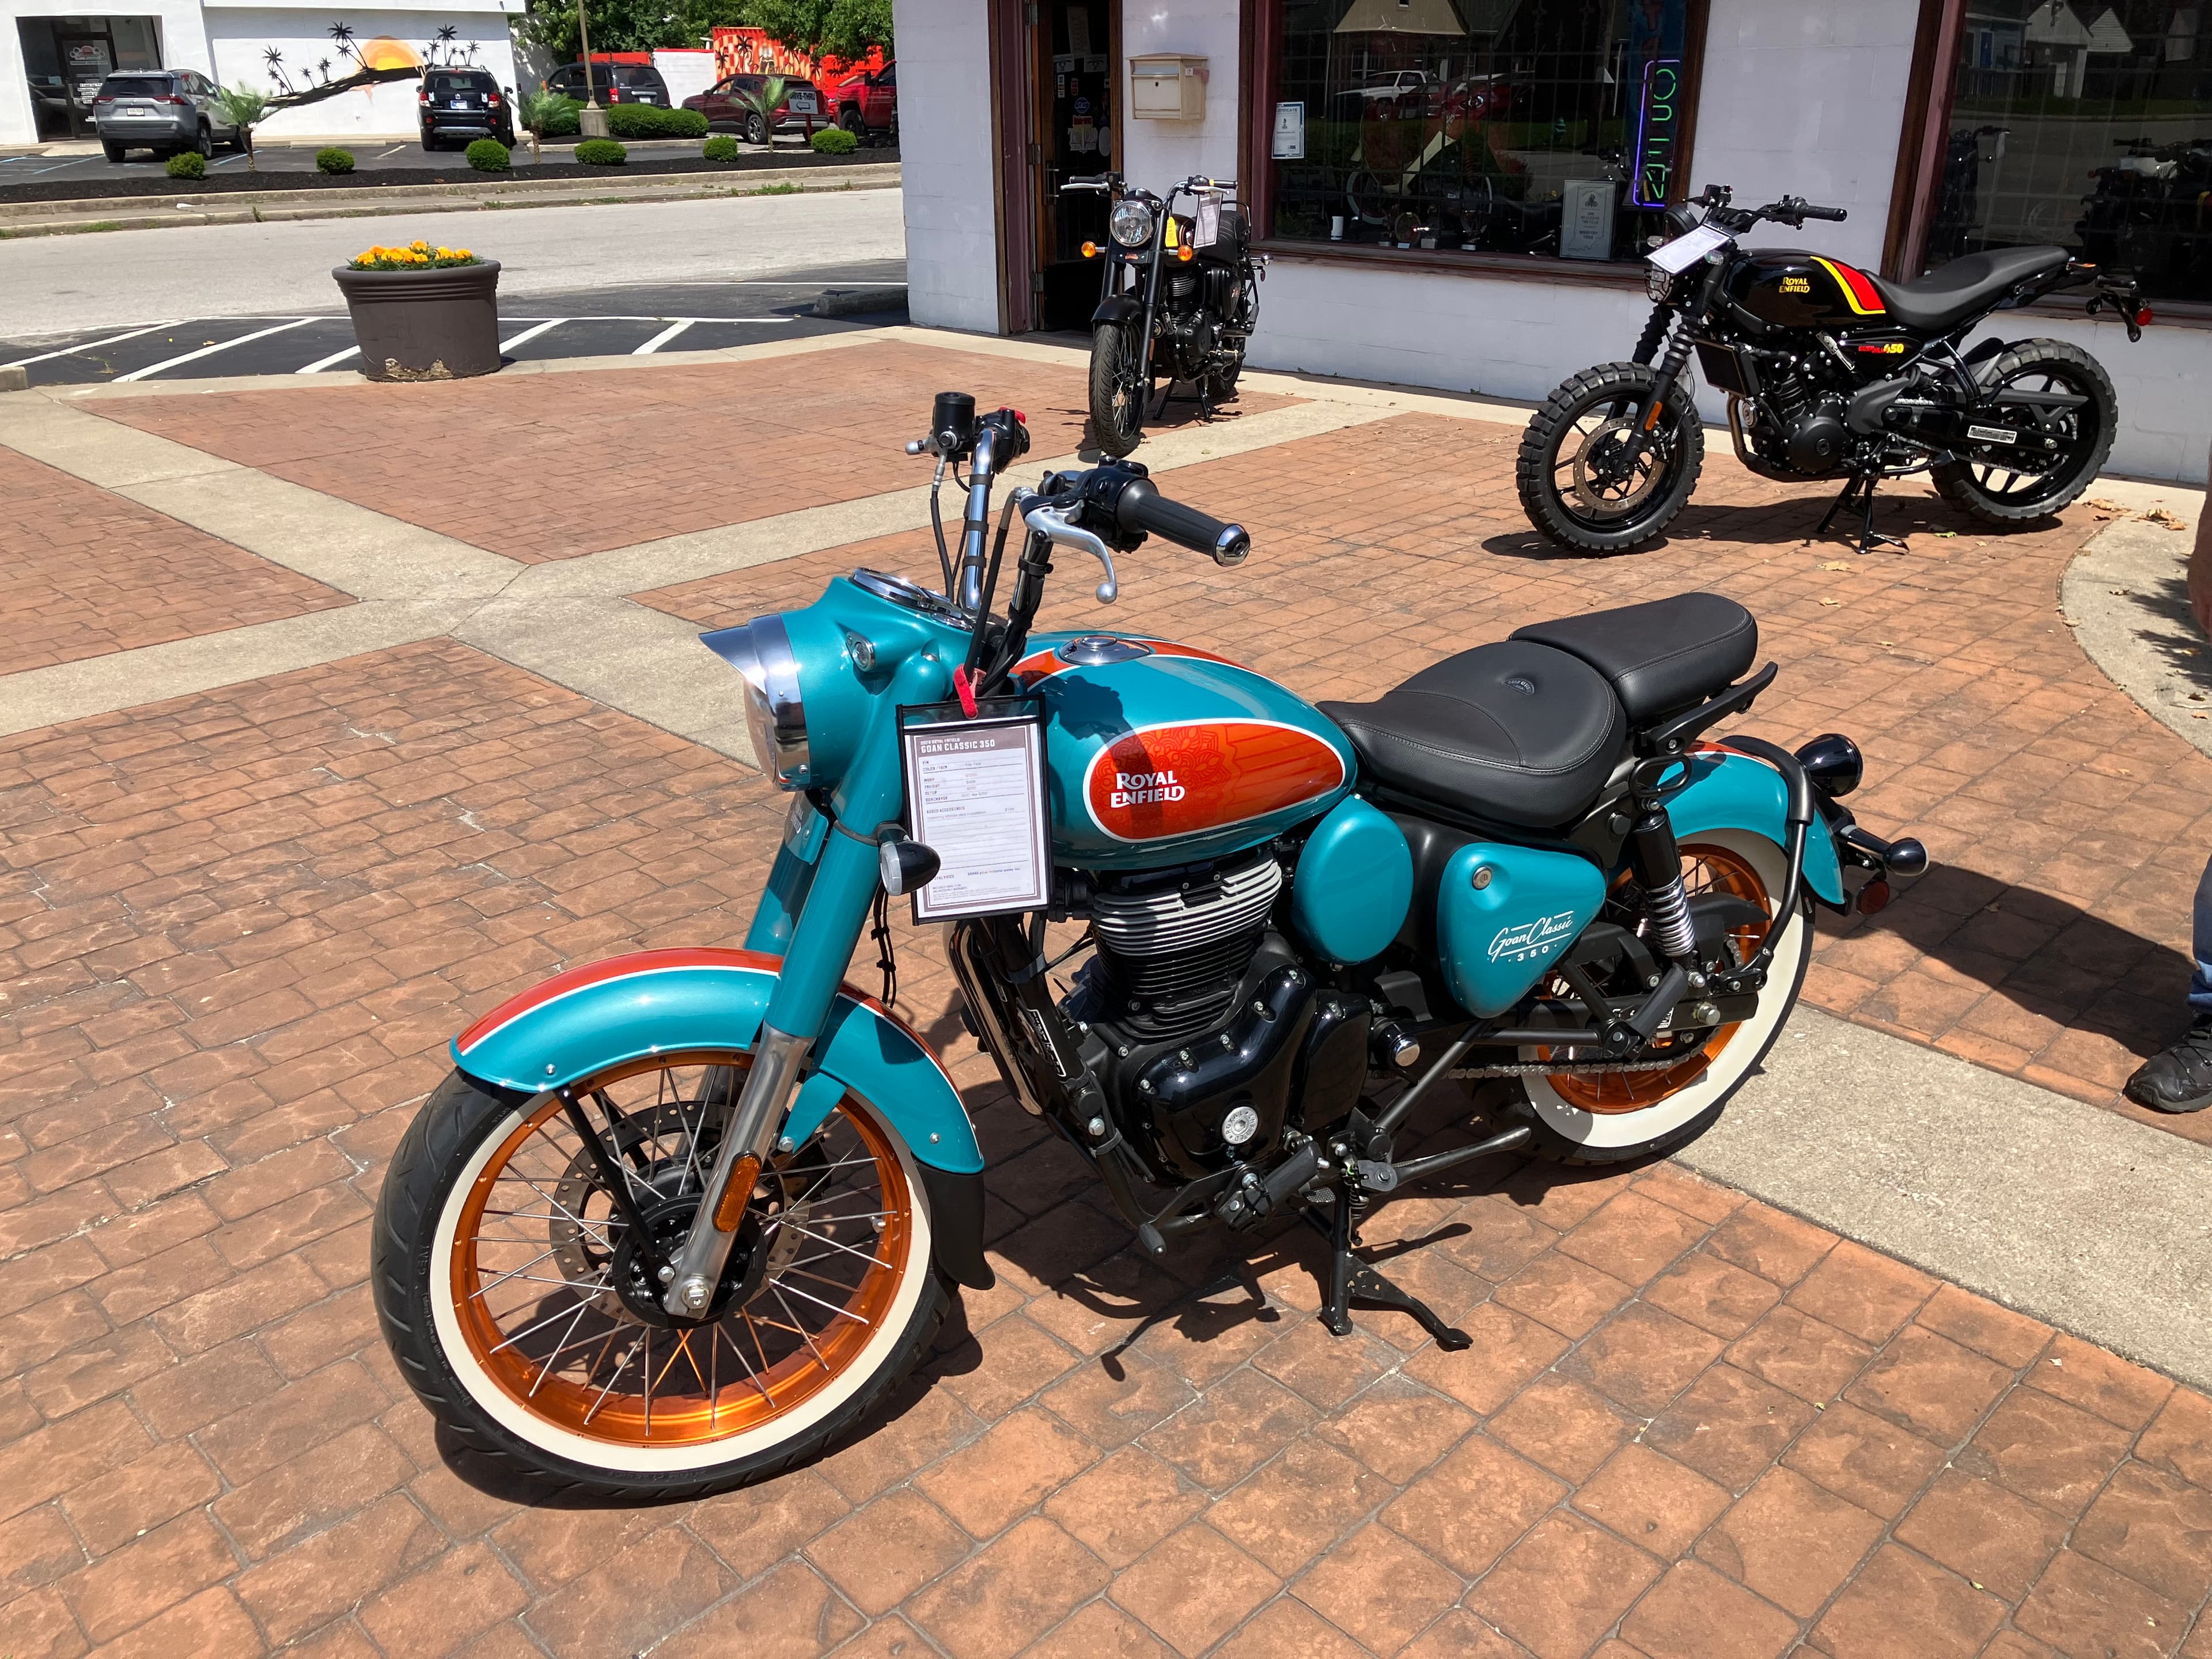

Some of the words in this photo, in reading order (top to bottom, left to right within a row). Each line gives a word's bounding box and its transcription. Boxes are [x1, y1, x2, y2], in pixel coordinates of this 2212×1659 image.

[1782, 277, 1808, 285] ROYAL
[1883, 343, 1904, 354] 450
[921, 744, 942, 753] GOAN
[944, 741, 978, 751] CLASSIC
[979, 739, 995, 748] 350
[1116, 770, 1177, 790] ROYAL
[1111, 786, 1185, 808] ENFIELD
[1488, 927, 1527, 963] Goan
[1525, 916, 1573, 945] Classic
[1517, 945, 1549, 962] 350
